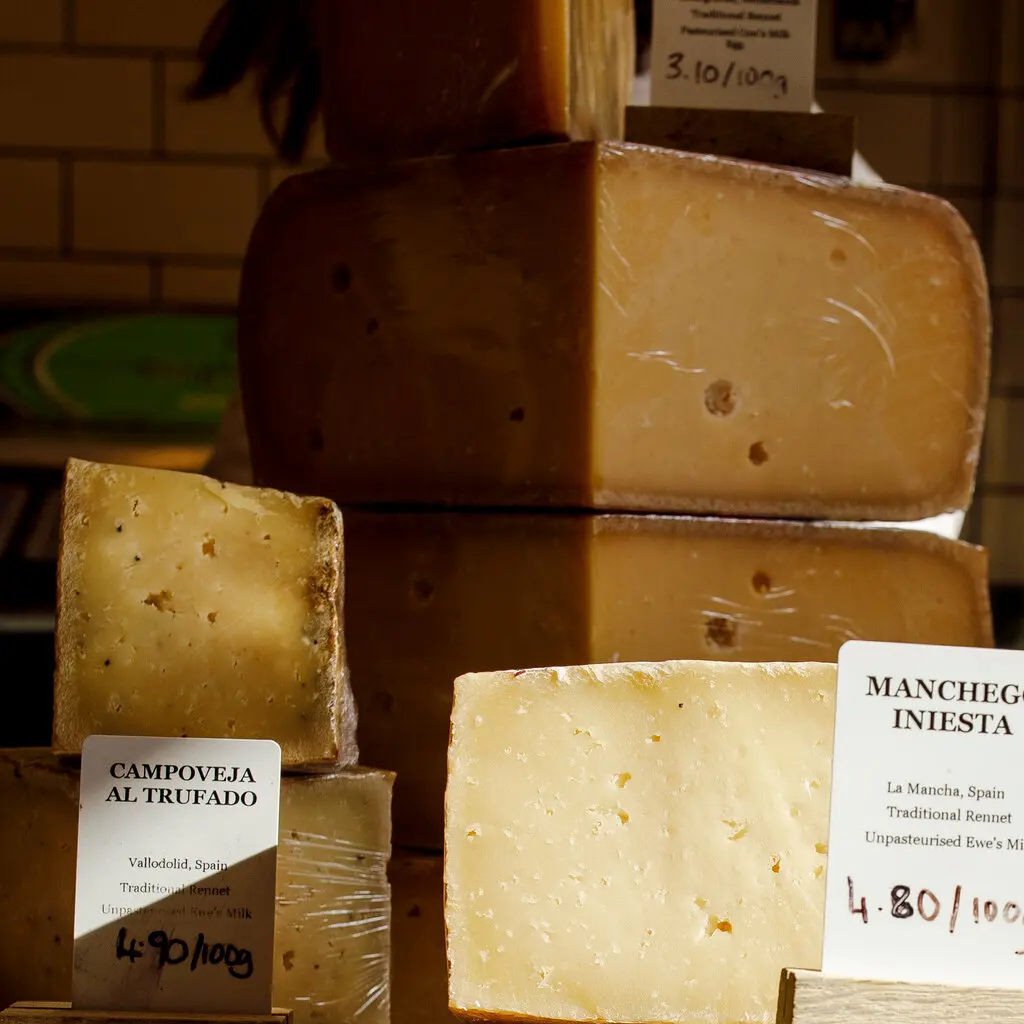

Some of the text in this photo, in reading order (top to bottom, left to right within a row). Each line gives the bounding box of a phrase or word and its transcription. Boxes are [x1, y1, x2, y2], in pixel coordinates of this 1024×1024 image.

[892, 709, 1014, 735] INIESTA
[110, 762, 256, 783] CAMPOVEJA
[105, 787, 258, 807] AL TRUFADO
[887, 781, 1005, 800] La Mancha, Spain
[887, 805, 1012, 824] Traditional Rennet
[865, 831, 962, 849] Unpasteurised
[966, 836, 1003, 850] Ewe's
[128, 858, 229, 873] Vallodolid, Spain
[120, 882, 230, 896] Traditional Rennet
[226, 909, 253, 920] Milk
[116, 927, 253, 979] 4.90/100g
